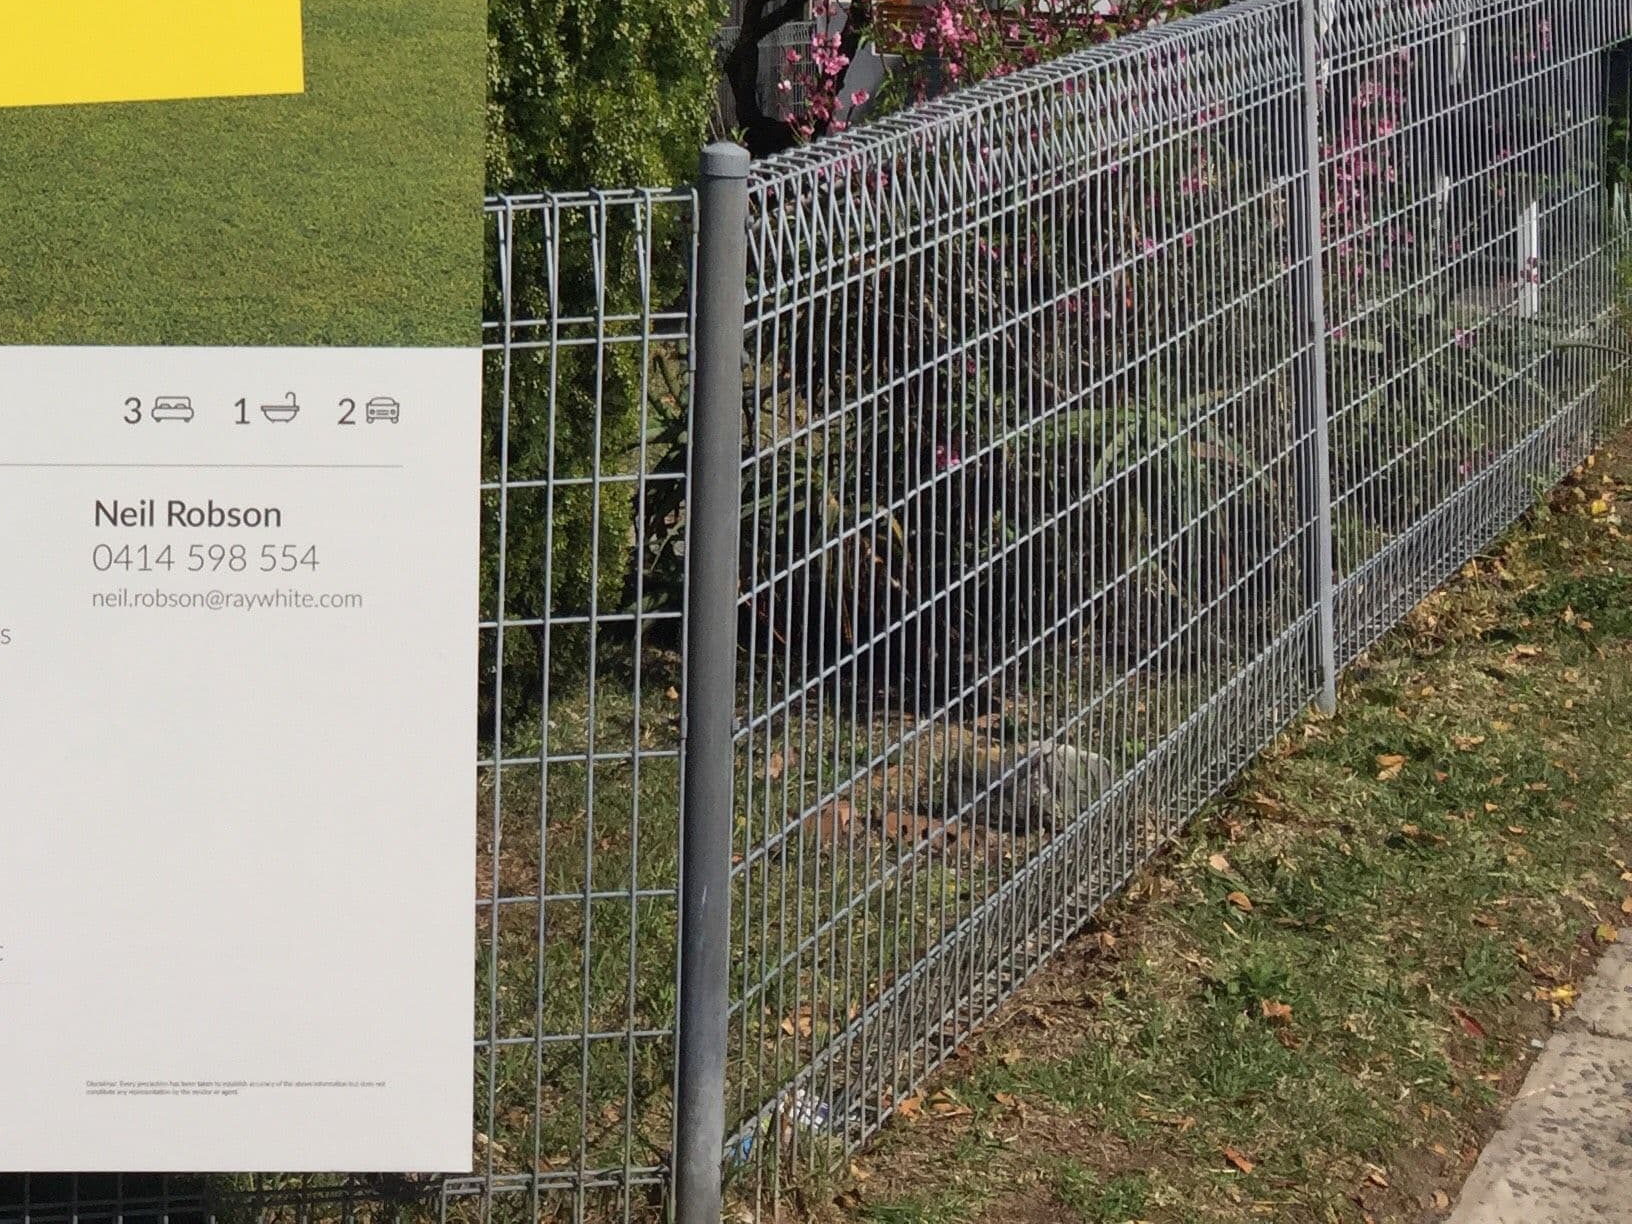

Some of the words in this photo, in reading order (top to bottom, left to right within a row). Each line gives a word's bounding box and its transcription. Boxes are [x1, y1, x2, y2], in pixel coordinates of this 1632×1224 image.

[123, 396, 143, 425] 3
[234, 397, 251, 425] 1
[337, 397, 356, 426] 2
[94, 498, 155, 528] Neil
[167, 499, 282, 528] Robson
[92, 543, 176, 572] 0414
[187, 543, 247, 573] 598
[259, 544, 320, 573] 554
[92, 587, 363, 612] neil.robson@raywhite.com
